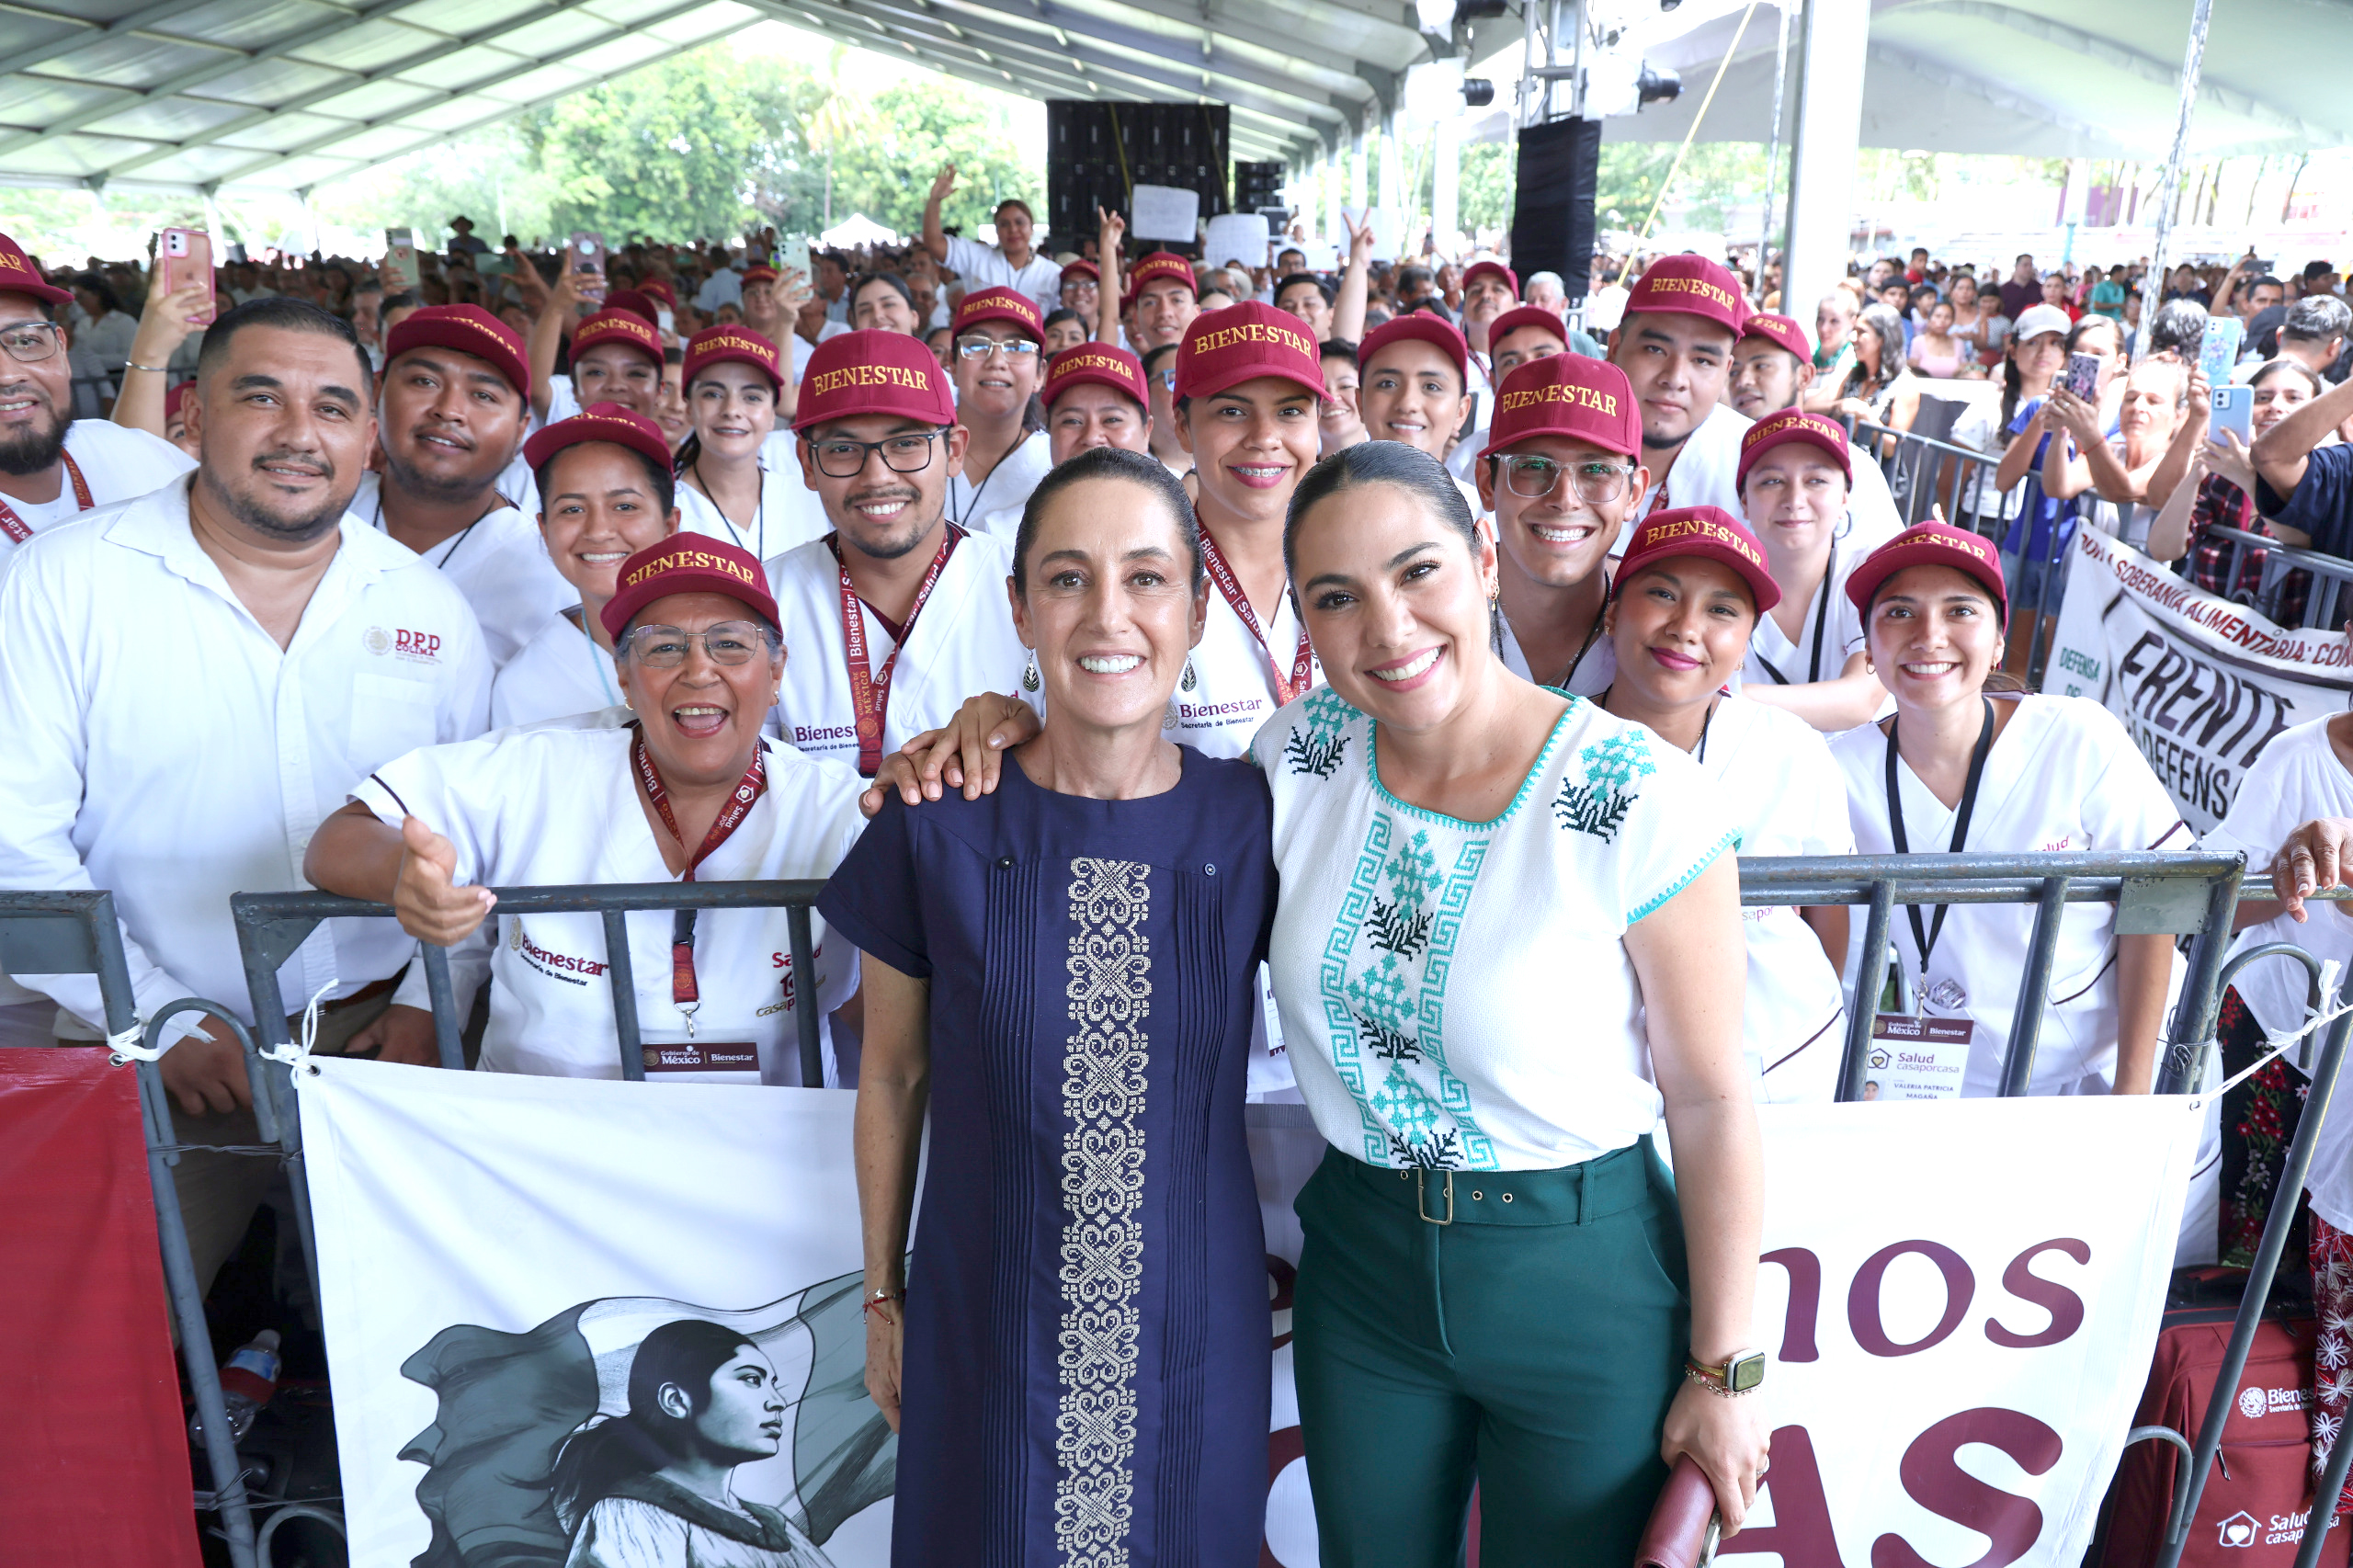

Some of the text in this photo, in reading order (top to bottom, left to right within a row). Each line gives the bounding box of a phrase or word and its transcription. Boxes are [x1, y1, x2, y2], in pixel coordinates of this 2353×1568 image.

[1650, 278, 1735, 312] BIENESTAR
[962, 297, 1037, 324] BIENESTAR
[577, 318, 653, 344] BIENESTAR
[1194, 324, 1313, 359] BIENESTAR
[694, 336, 775, 363] BIENESTAR
[812, 365, 929, 396] BIENESTAR
[1051, 355, 1134, 381] BIENESTAR
[1502, 384, 1618, 416] BIENESTAR
[1747, 416, 1841, 447] BIENESTAR
[1645, 520, 1762, 567] BIENESTAR
[626, 550, 755, 586] BIENESTAR
[1200, 538, 1237, 596] Bienestar
[847, 594, 862, 657] Bienestar
[395, 629, 440, 651] DPD
[395, 643, 435, 656] COLIMA
[860, 671, 873, 714] MÉXICO
[875, 689, 885, 711] Salud
[2119, 631, 2295, 769] FRENTE
[1179, 699, 1262, 718] Bienestar
[1226, 717, 1254, 725] Bienestar
[725, 805, 744, 828] Salud
[522, 932, 608, 976] Bienestar
[554, 972, 588, 986] Bienestar
[1887, 1027, 1966, 1036] México Bienestar
[662, 1053, 754, 1064] México Bienestar
[1897, 1062, 1960, 1074] casaporcasa
[1898, 1052, 1935, 1063] Salud
